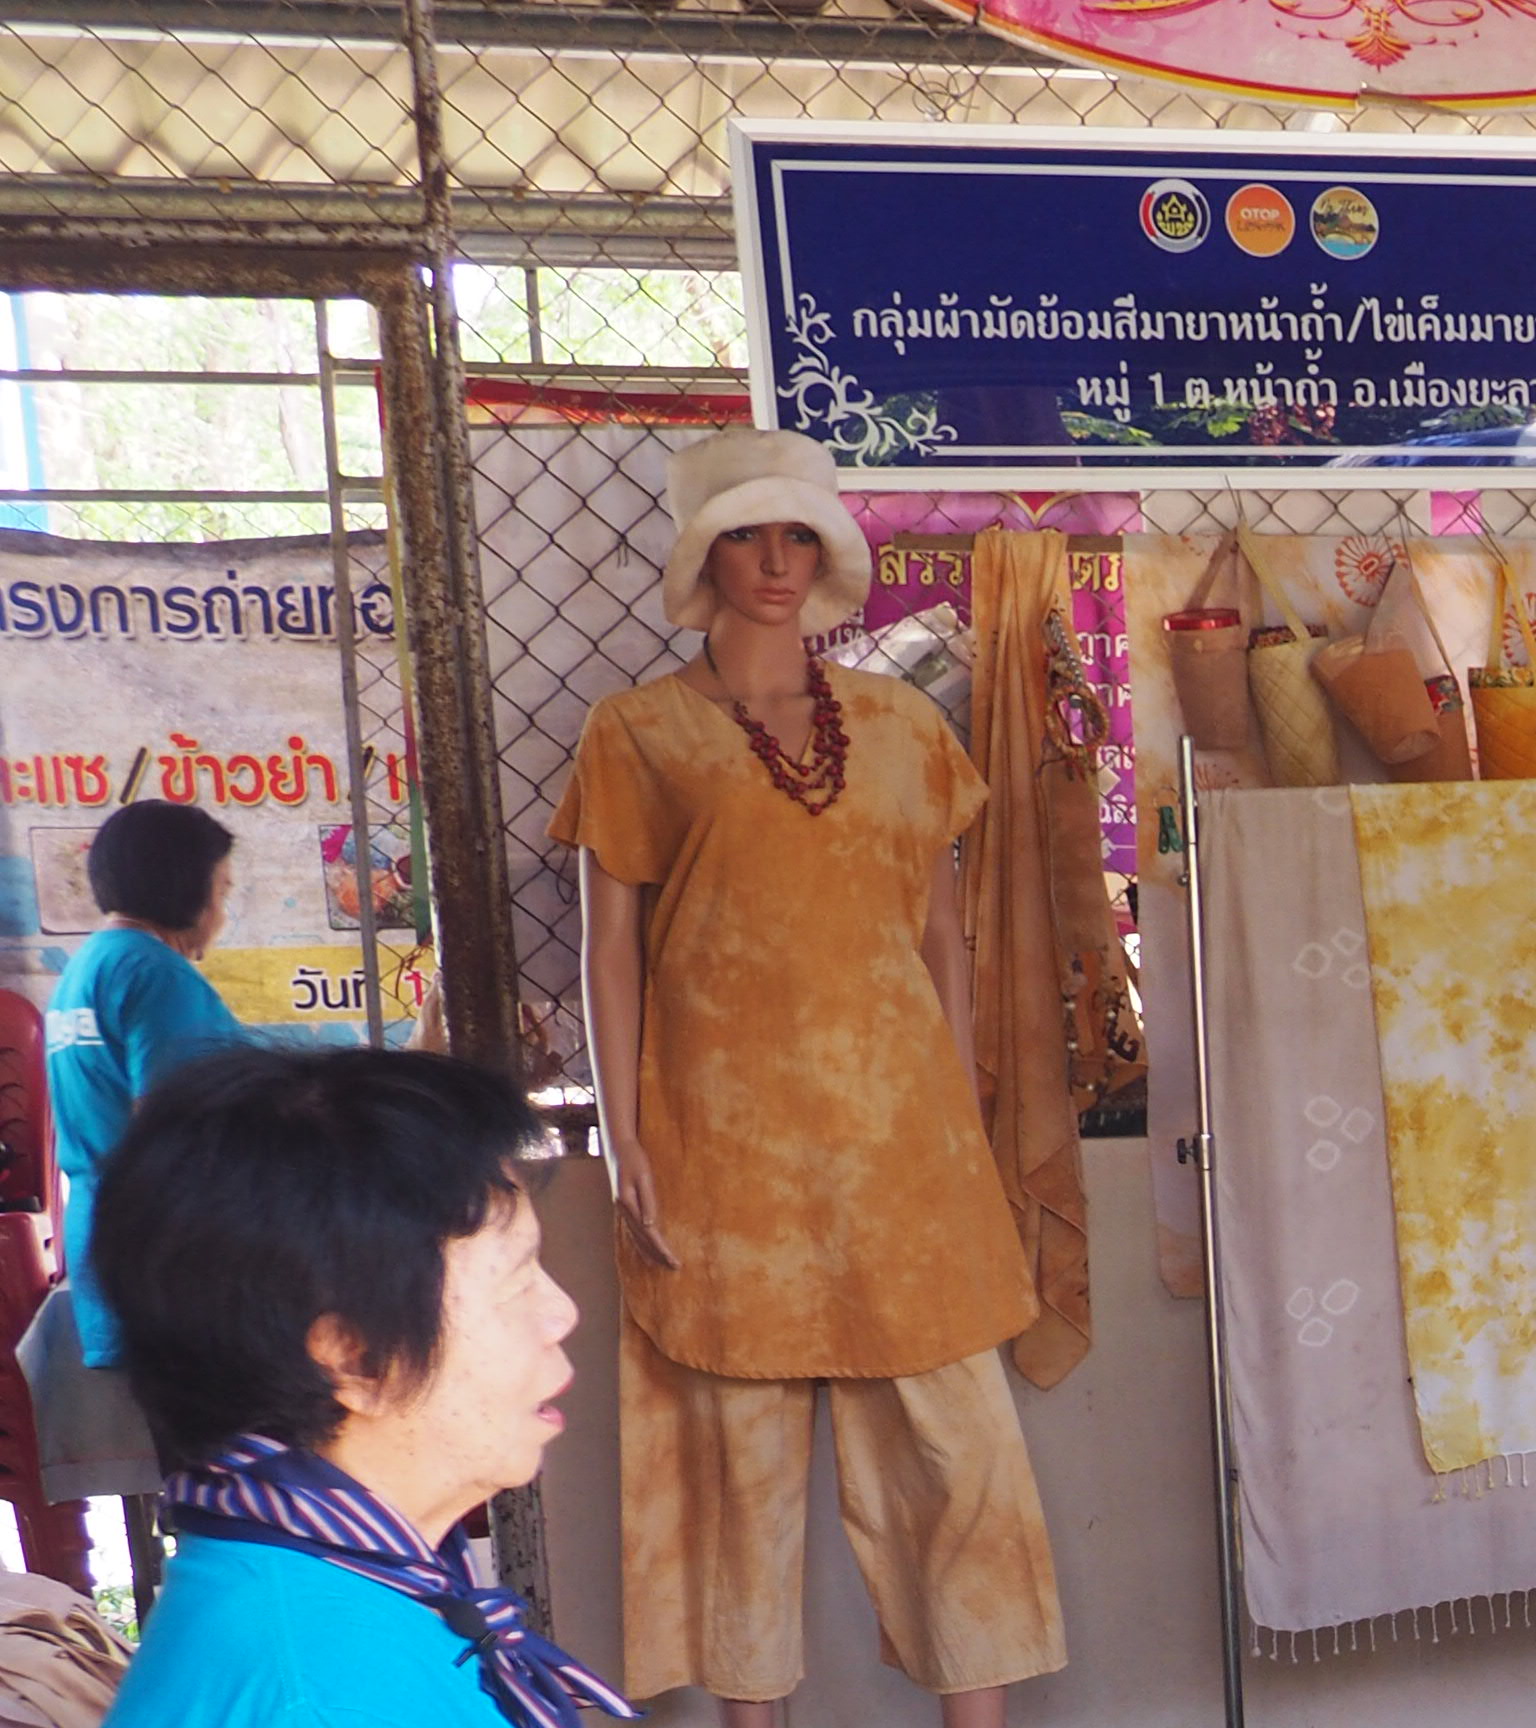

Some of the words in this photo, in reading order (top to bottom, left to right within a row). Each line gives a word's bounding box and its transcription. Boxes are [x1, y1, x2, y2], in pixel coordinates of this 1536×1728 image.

[1240, 207, 1282, 221] OTOP
[1076, 360, 1131, 423] หมู่
[1149, 372, 1164, 408] 1
[1185, 347, 1338, 409] ต.หน้าถ้ำ
[0, 569, 396, 635] รงการถ่ายทอ
[158, 732, 338, 803] ข้าวยำ
